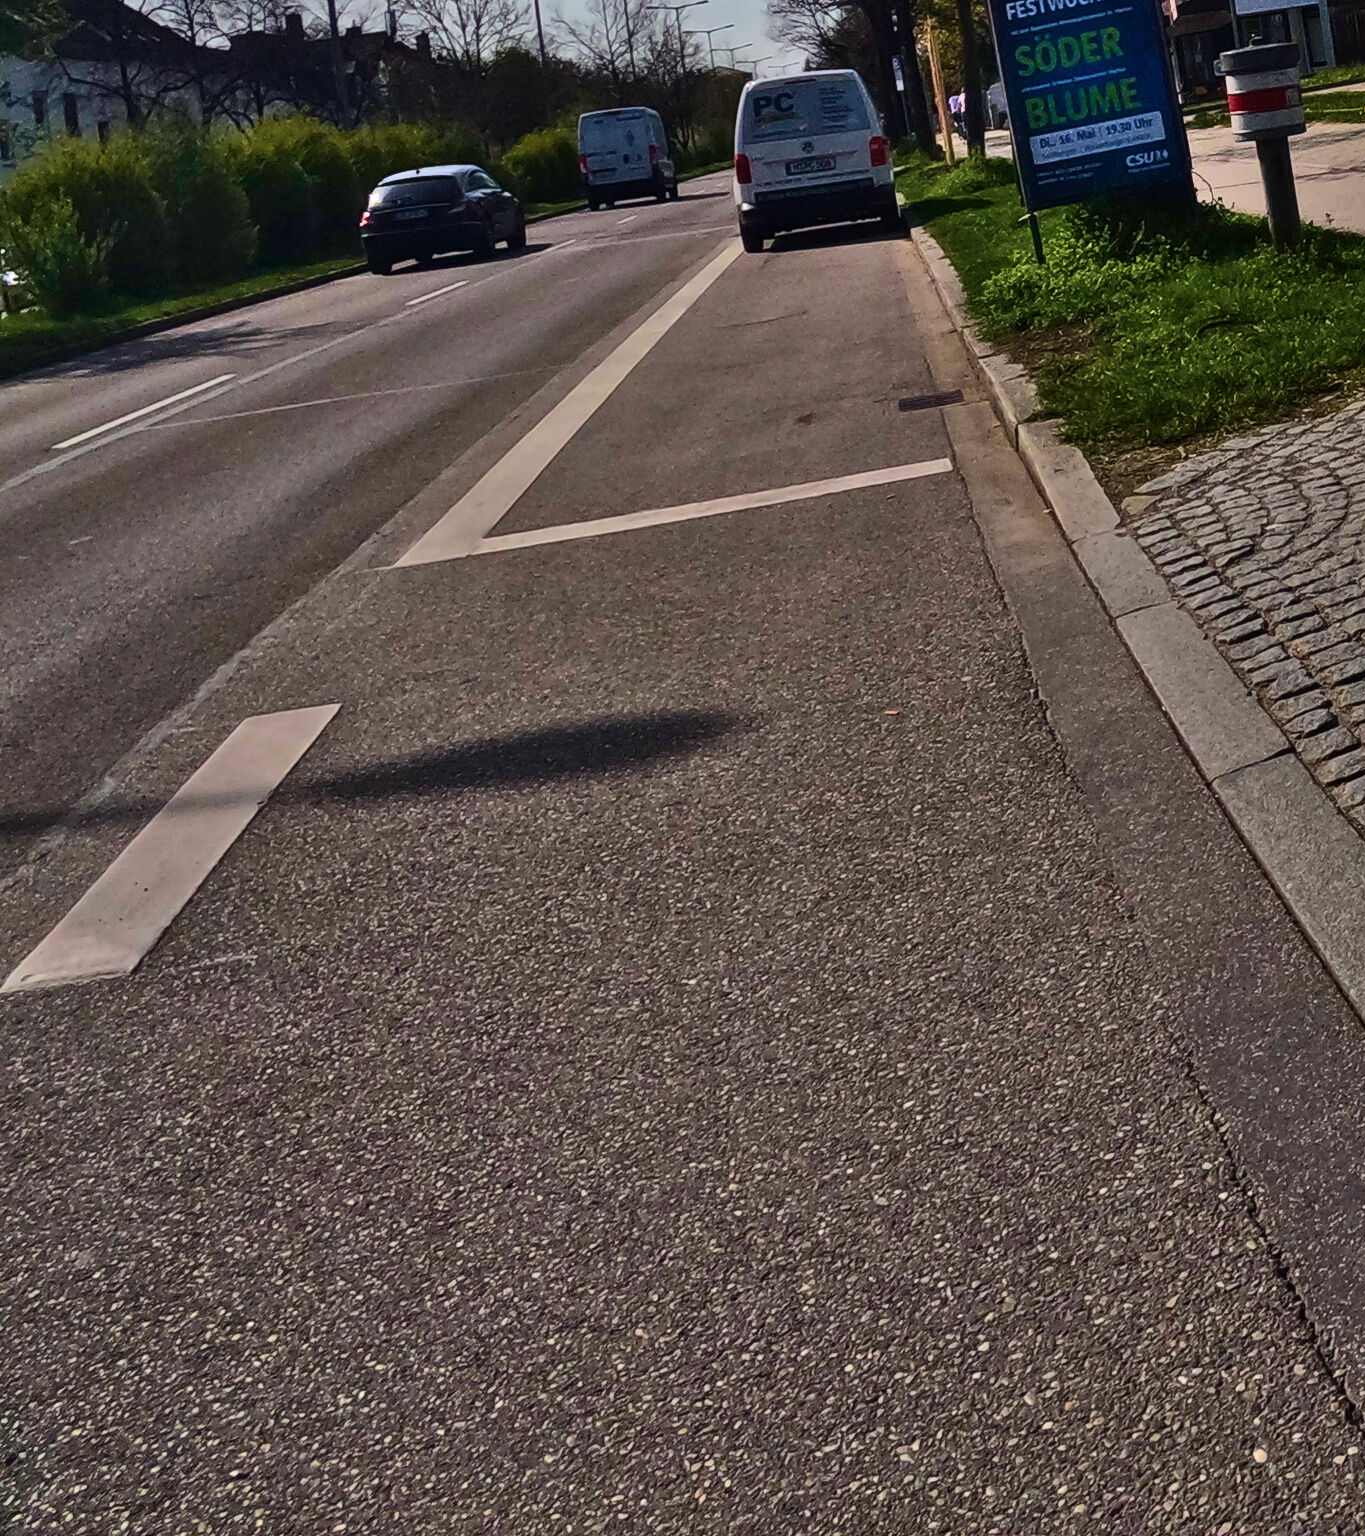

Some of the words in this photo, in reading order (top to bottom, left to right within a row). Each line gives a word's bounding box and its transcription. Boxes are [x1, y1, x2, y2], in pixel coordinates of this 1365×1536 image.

[1014, 27, 1124, 77] SÖDER
[753, 91, 795, 118] PC
[1025, 77, 1142, 129] BLUME
[1134, 116, 1154, 129] Uhr
[1126, 151, 1154, 167] CSU
